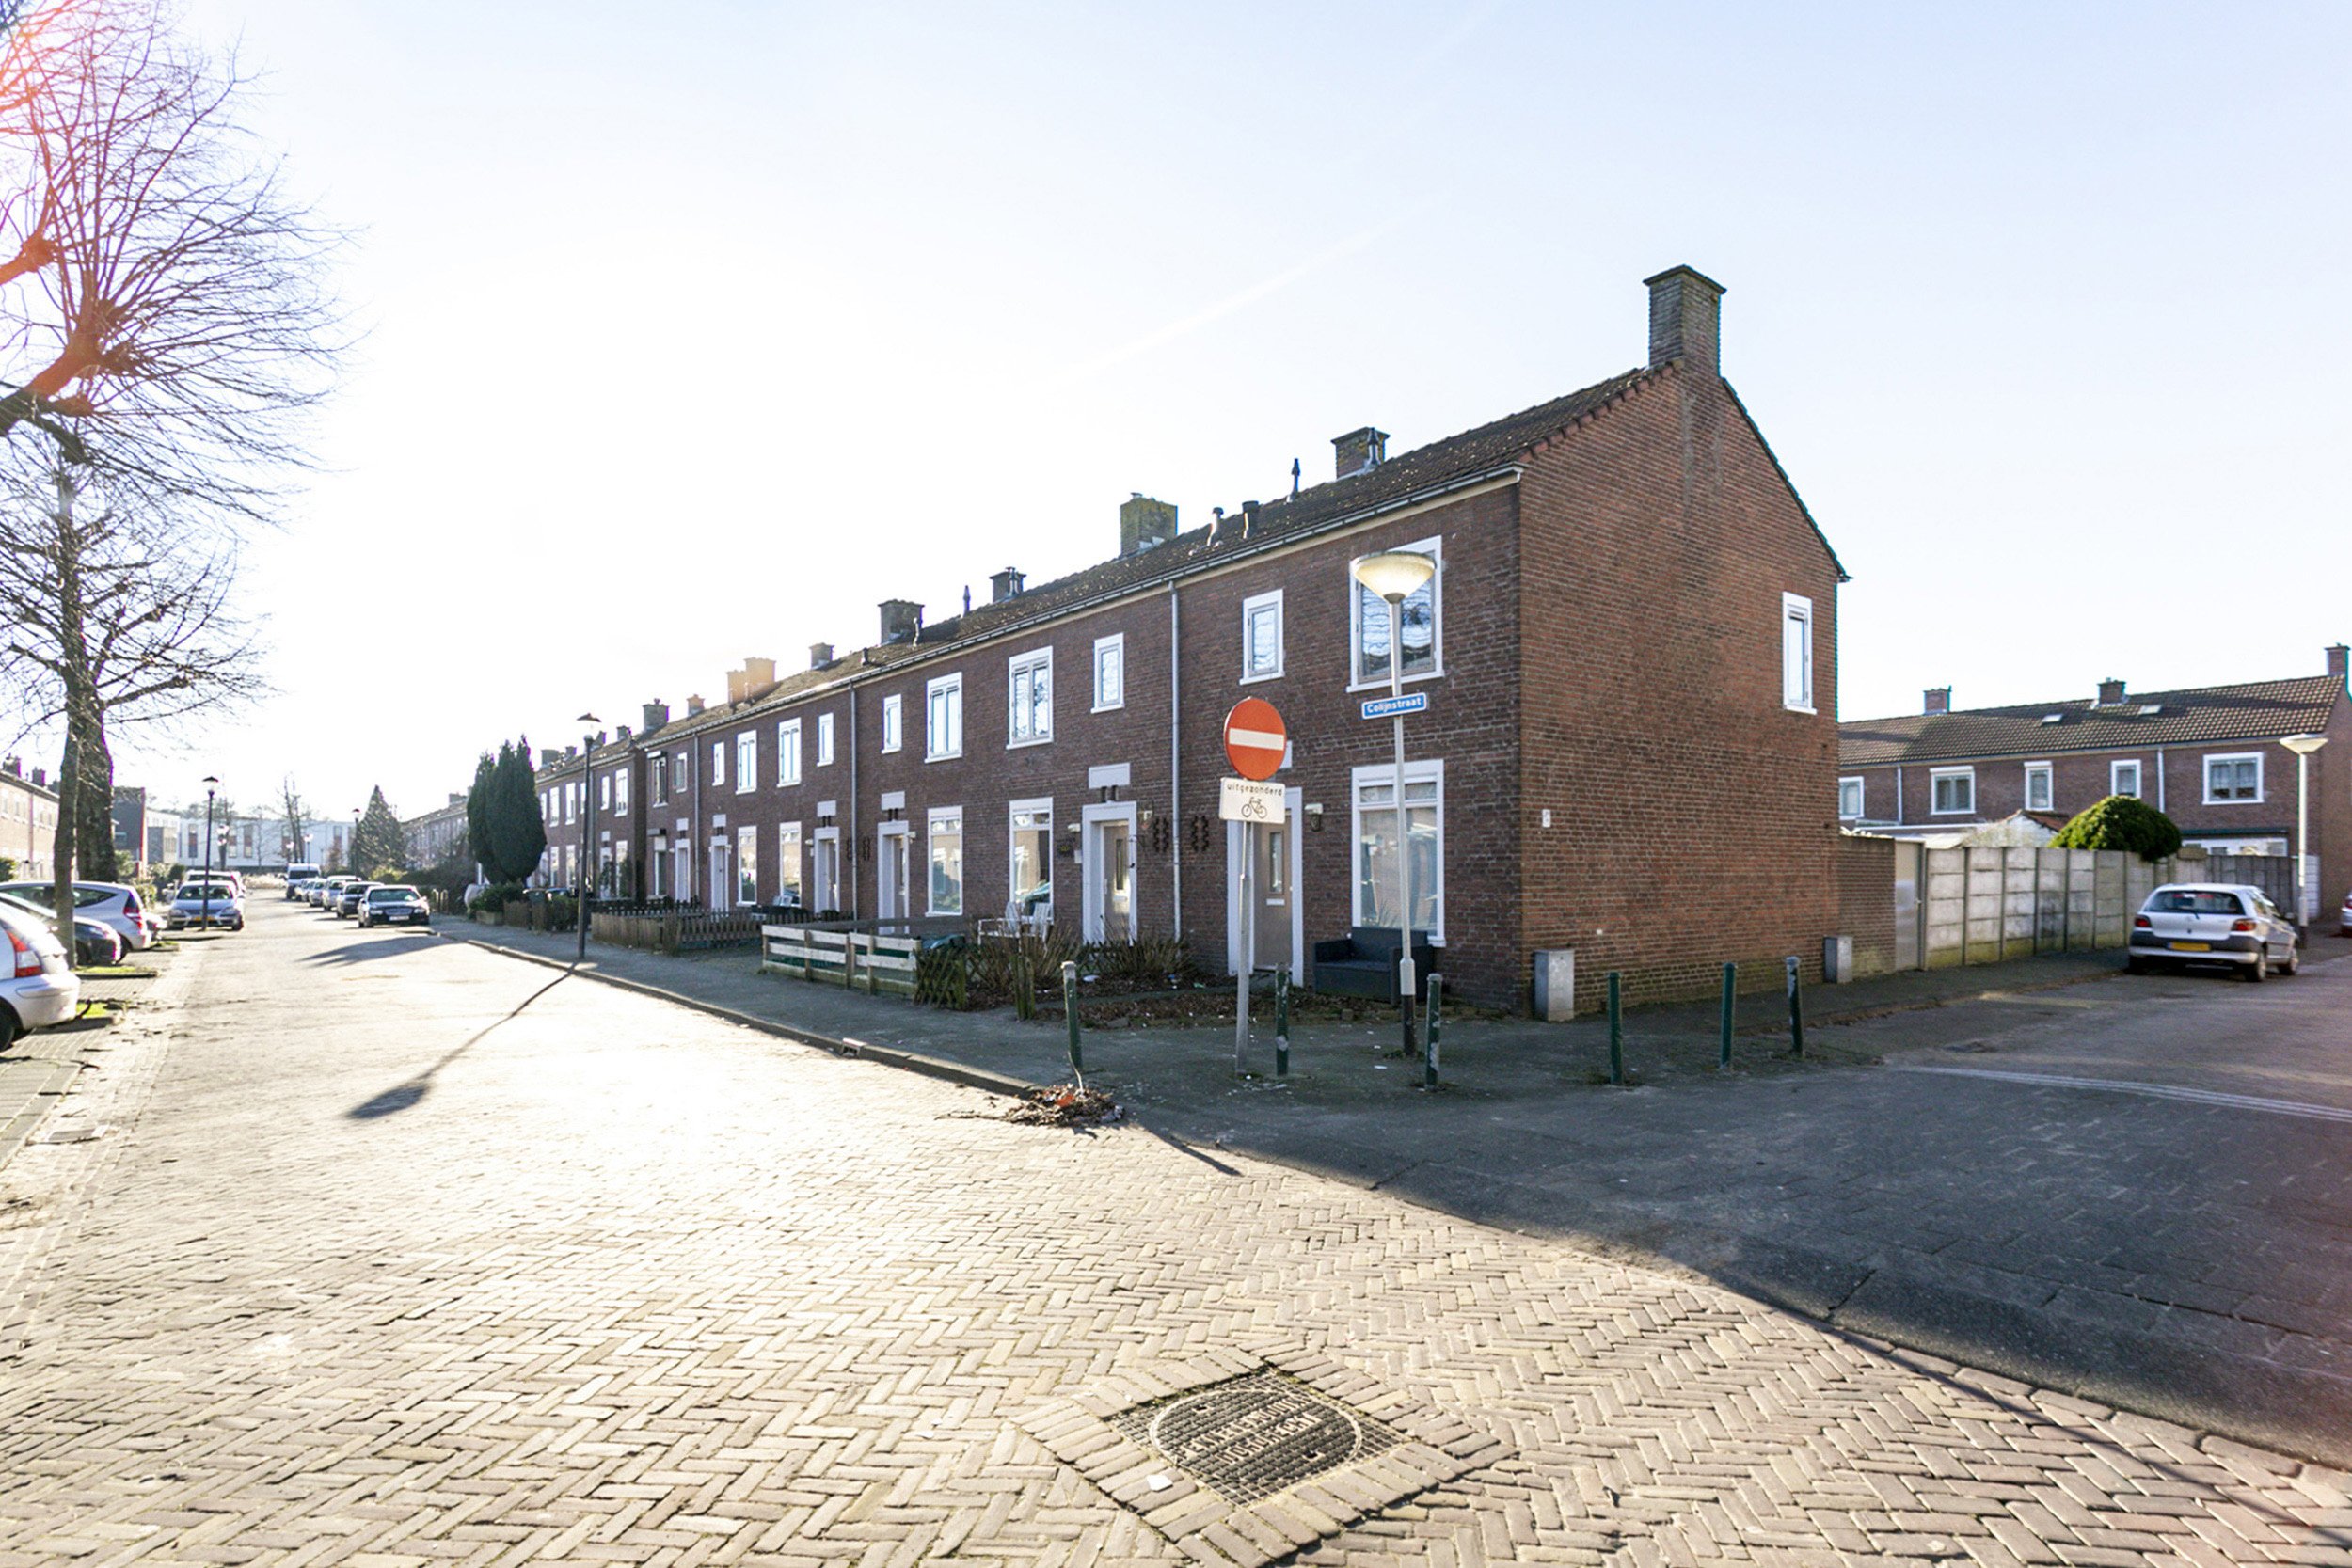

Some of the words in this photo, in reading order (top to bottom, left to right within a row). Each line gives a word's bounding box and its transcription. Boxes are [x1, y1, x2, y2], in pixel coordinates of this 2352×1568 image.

[1367, 697, 1422, 713] Colijnstraat
[1227, 783, 1282, 797] uitgezonderd
[1216, 1412, 1323, 1465] DORDRECHT
